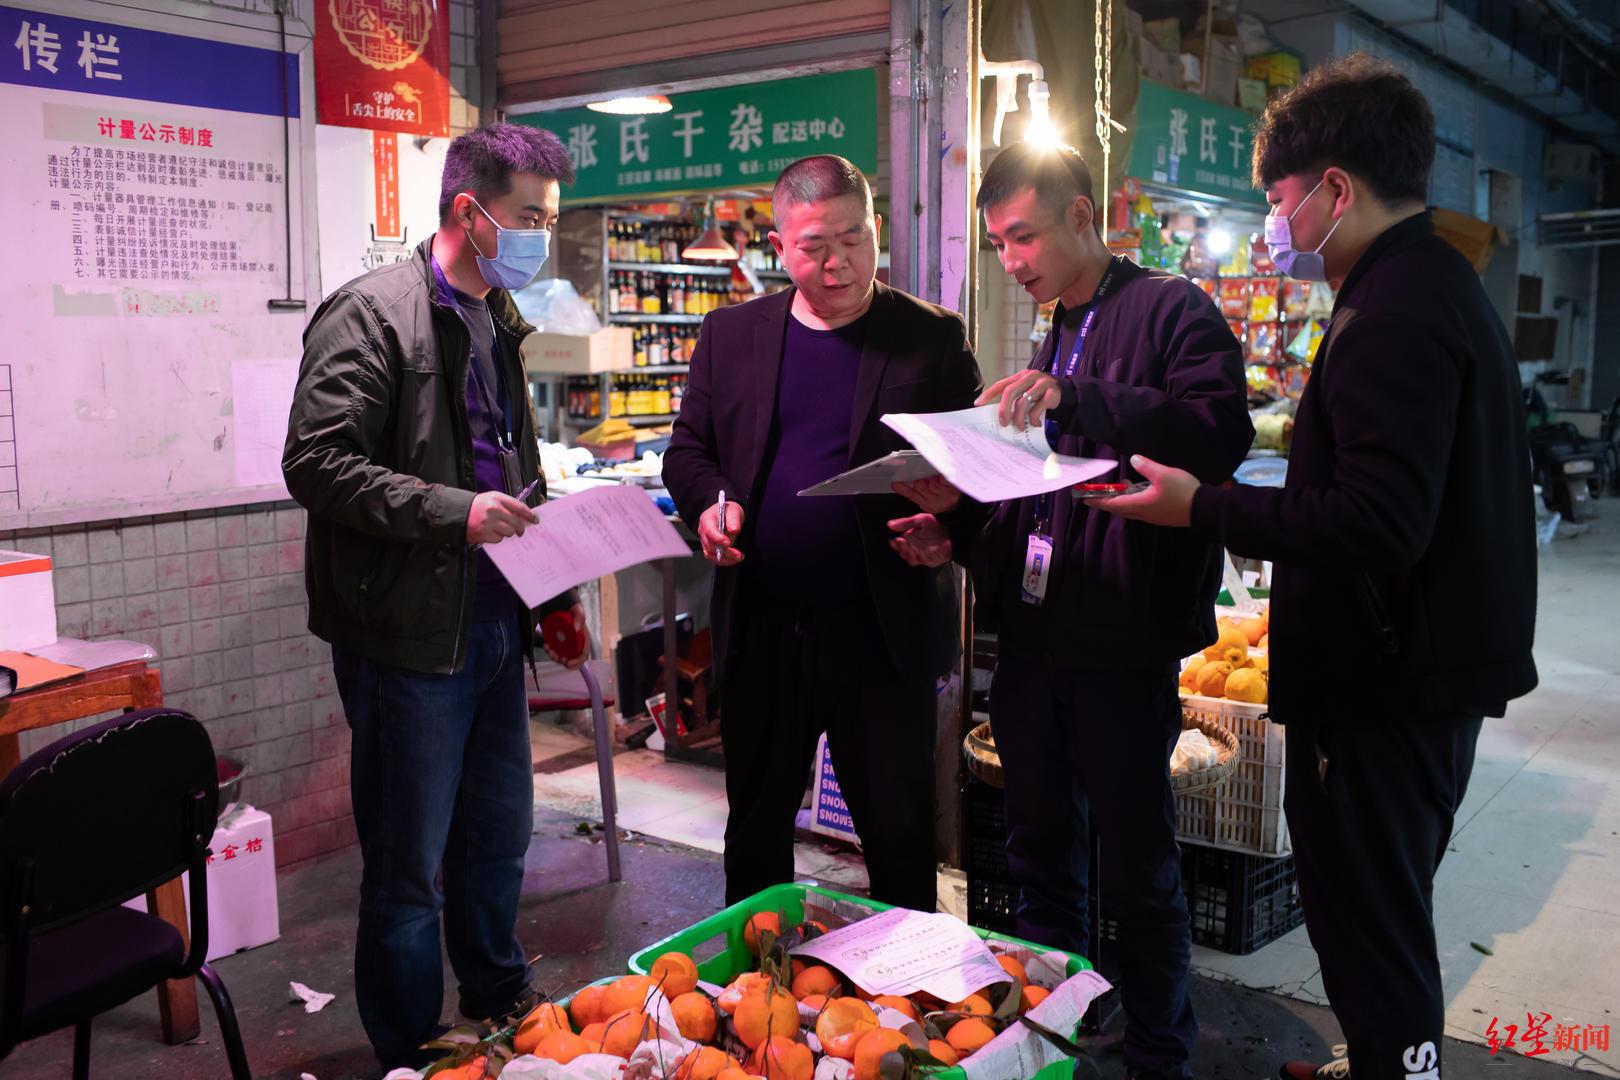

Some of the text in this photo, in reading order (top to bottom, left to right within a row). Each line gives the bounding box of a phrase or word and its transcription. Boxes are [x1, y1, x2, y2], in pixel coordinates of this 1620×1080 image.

[14, 20, 123, 81] 传栏
[372, 91, 394, 105] 守护
[352, 102, 415, 121] 舌尖上的安全
[97, 117, 214, 148] 计量公示制度
[568, 103, 846, 170] 张氏干杂 配送中心
[819, 808, 854, 828] EMONS
